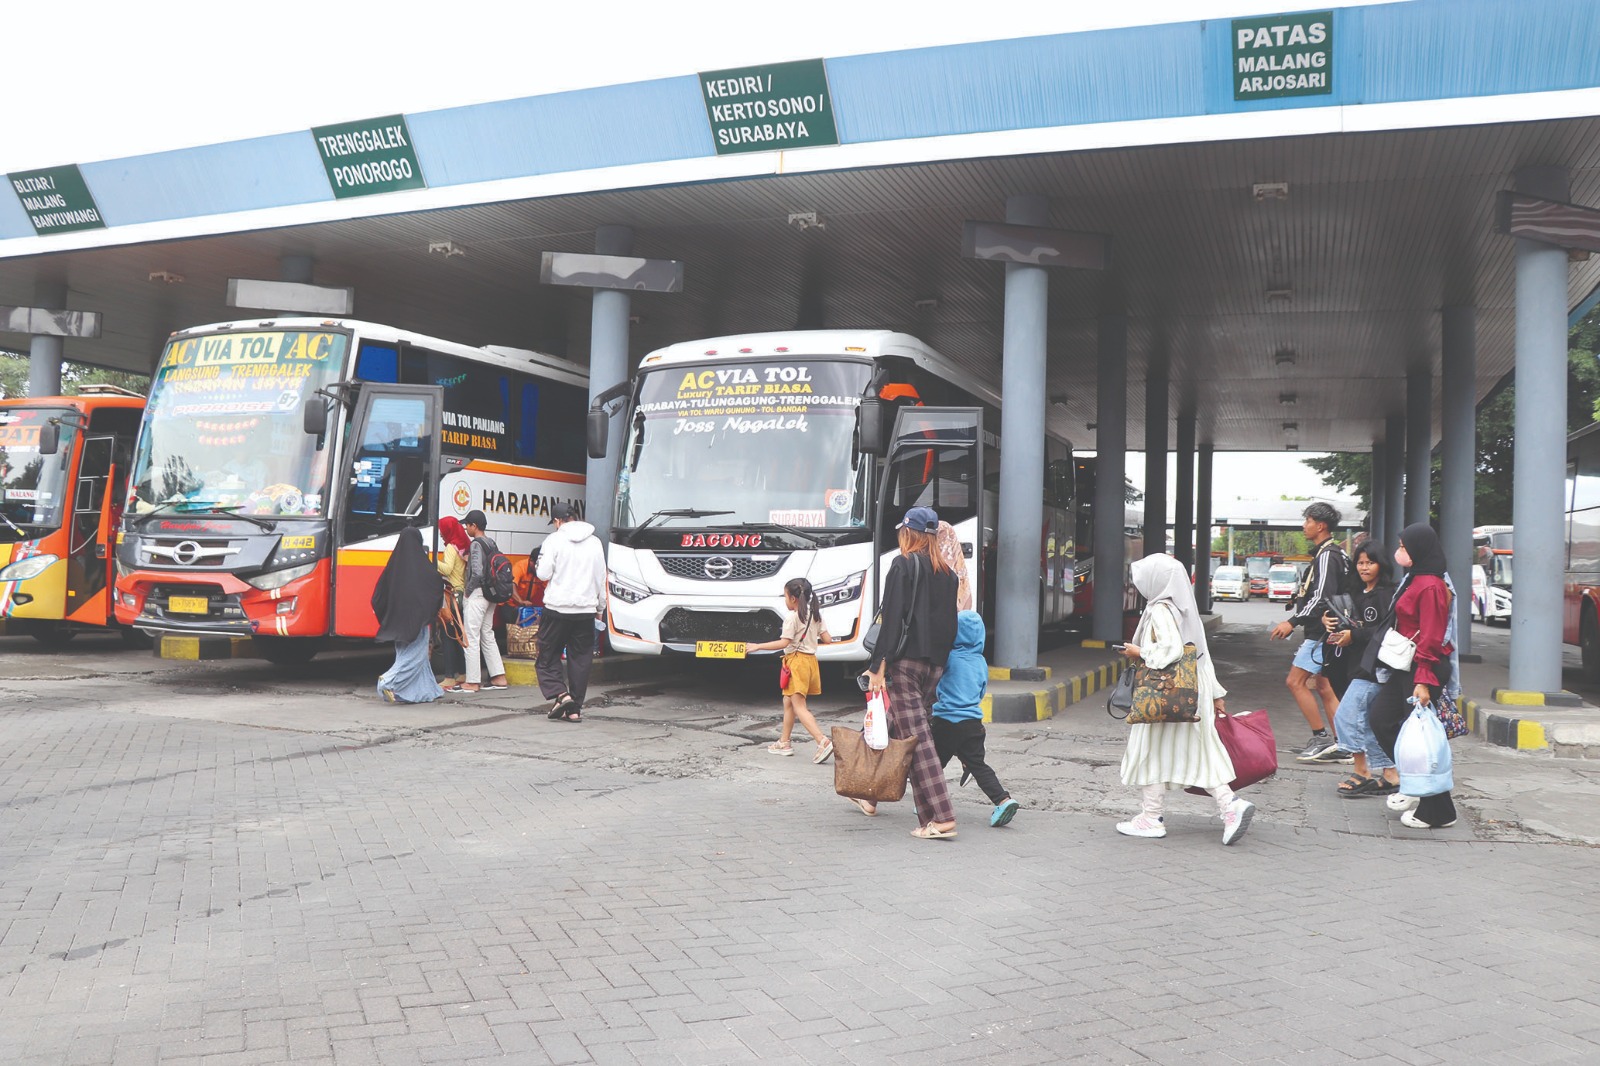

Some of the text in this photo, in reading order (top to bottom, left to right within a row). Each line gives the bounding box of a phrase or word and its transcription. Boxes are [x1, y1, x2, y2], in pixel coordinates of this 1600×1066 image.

[1237, 22, 1327, 49] PATAS
[1238, 51, 1327, 73] MALANG
[706, 75, 763, 98] KEDIRI
[1239, 72, 1326, 92] ARJOSARI
[712, 95, 816, 122] KERTOSONO
[318, 125, 407, 157] TRENGGALEK
[718, 121, 809, 146] SURABAYA
[333, 158, 413, 188] PONOROGO
[13, 176, 51, 194] BLITAR
[22, 193, 67, 211] MALANG
[31, 208, 99, 228] BANYUWANGI
[162, 333, 335, 367] AC VIA TOL AC
[164, 363, 313, 382] LANGSUNG TRENGGALEK
[679, 367, 812, 391] AC VIA TOL
[677, 383, 813, 399] Luxury TARIF BIASA
[777, 405, 808, 413] BANDAR
[442, 411, 505, 435] VIA TOL PANJANG
[673, 418, 715, 435] Joss
[442, 430, 497, 450] TARIP BIASA
[681, 534, 762, 547] BAGONG
[697, 643, 703, 652] N
[734, 644, 745, 653] UG
